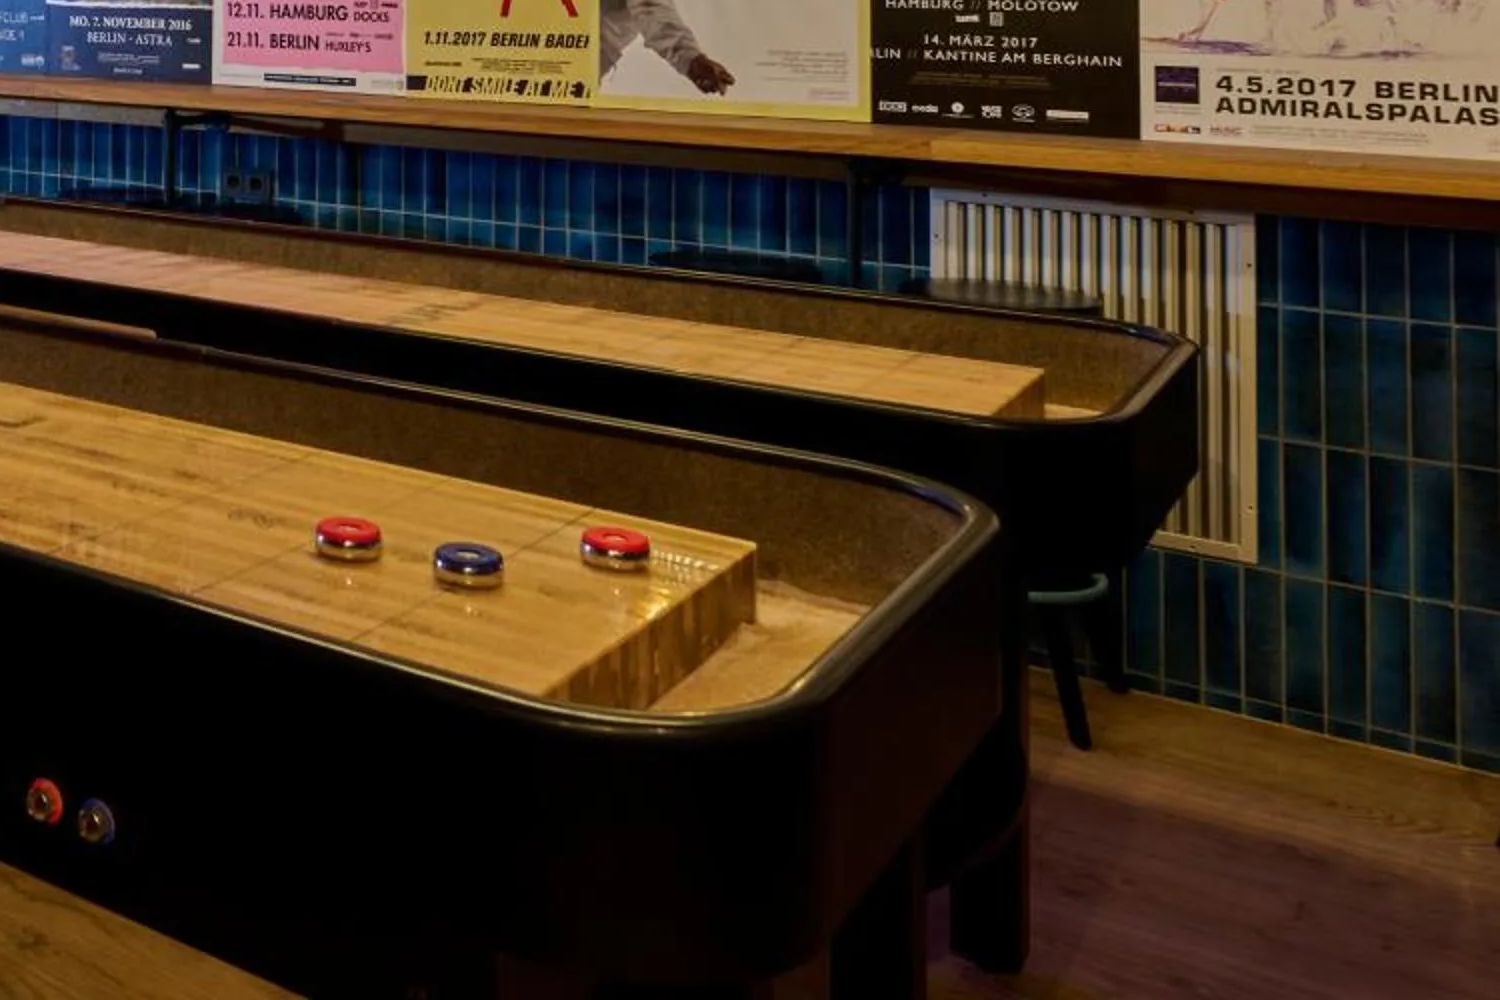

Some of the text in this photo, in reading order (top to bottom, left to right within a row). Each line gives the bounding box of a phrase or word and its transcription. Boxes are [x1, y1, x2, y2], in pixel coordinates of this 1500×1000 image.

[228, 2, 390, 23] 12.11. HAMBURG DOCKS
[69, 15, 91, 28] MO.
[103, 16, 165, 30] NOVEMBER
[168, 18, 193, 31] 2016
[87, 31, 173, 46] BERLIN ASTRA
[227, 31, 372, 53] 21.11. BERLIN HUXLEY'S
[424, 31, 540, 47] 1.11.2017 BERLIN
[923, 32, 1038, 49] 14. MÄRZ 2017
[923, 50, 997, 65] KANTINE
[1000, 51, 1026, 65] AM
[1033, 53, 1123, 68] BERGHAIN
[1215, 75, 1499, 103] 4.5.2017 BERLIN
[1215, 97, 1499, 126] ADMIRALSPALAS
